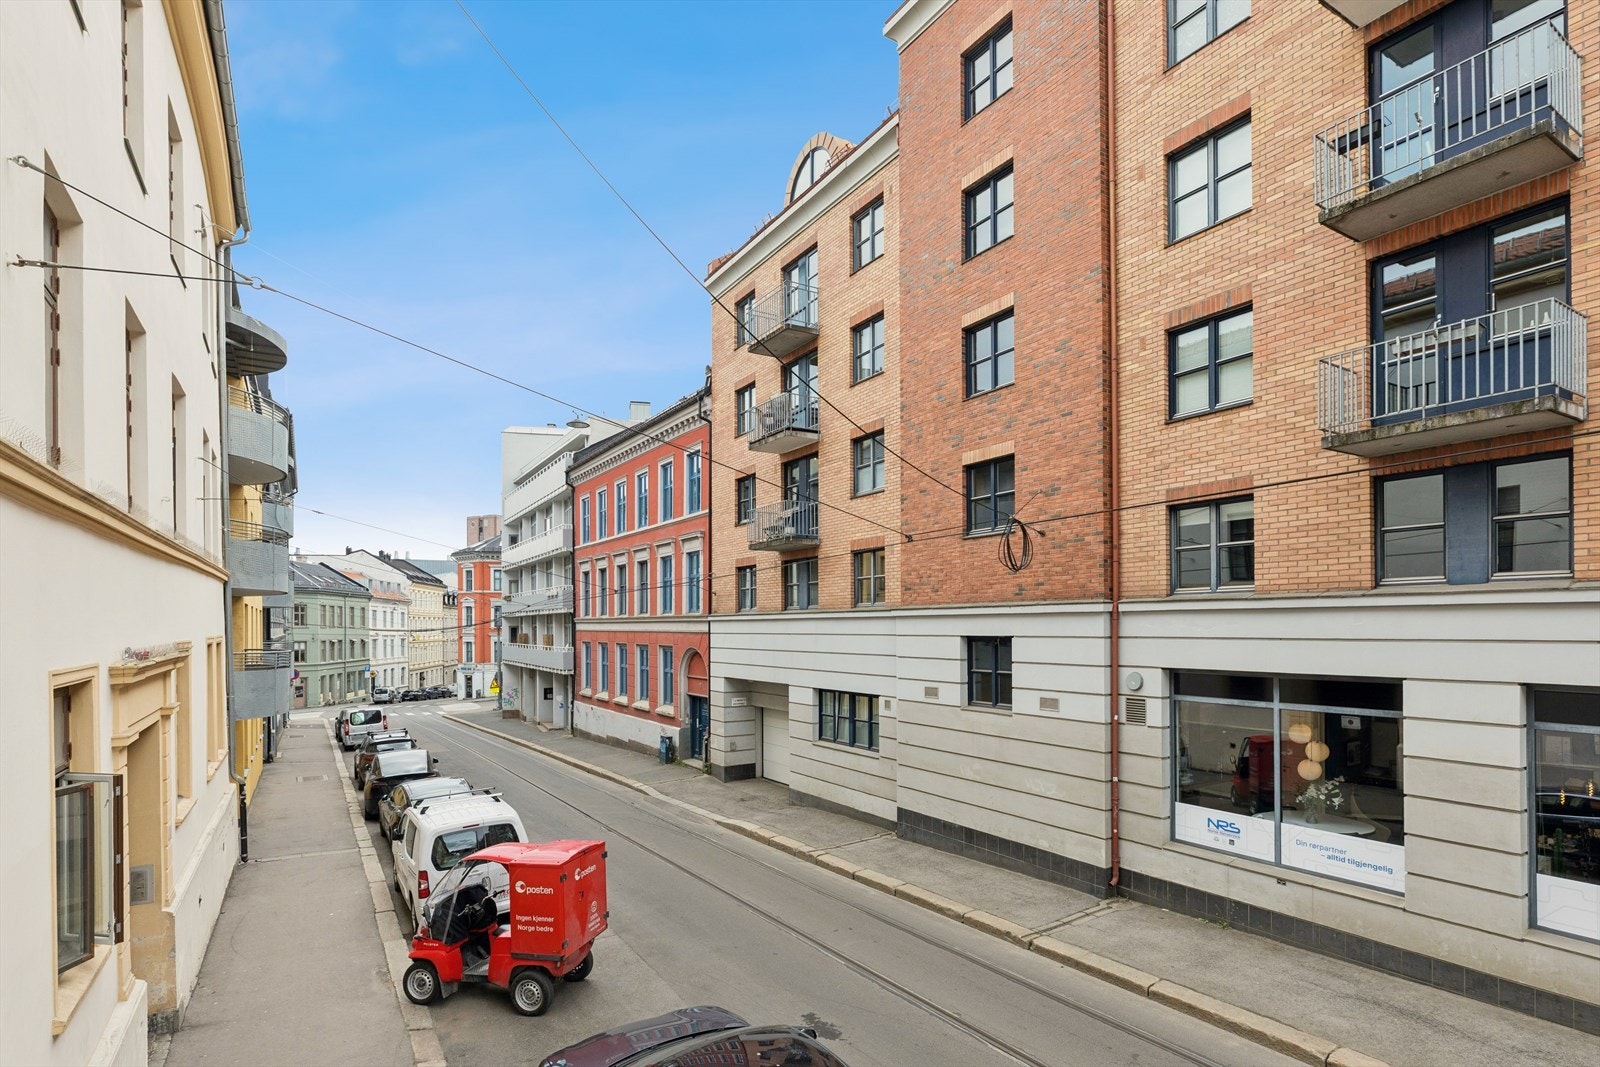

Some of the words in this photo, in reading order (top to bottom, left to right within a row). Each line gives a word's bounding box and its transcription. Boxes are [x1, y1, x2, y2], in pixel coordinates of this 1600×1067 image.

[1207, 817, 1241, 834] NRS
[1295, 839, 1308, 848] Din
[1309, 842, 1347, 856] rørpartner
[580, 864, 597, 879] posten
[1326, 853, 1346, 864] alltid
[1347, 858, 1394, 875] tilgjengelig
[526, 886, 554, 895] posten
[515, 914, 532, 922] Ingen
[532, 915, 554, 923] kjenner
[517, 924, 535, 933] Norge
